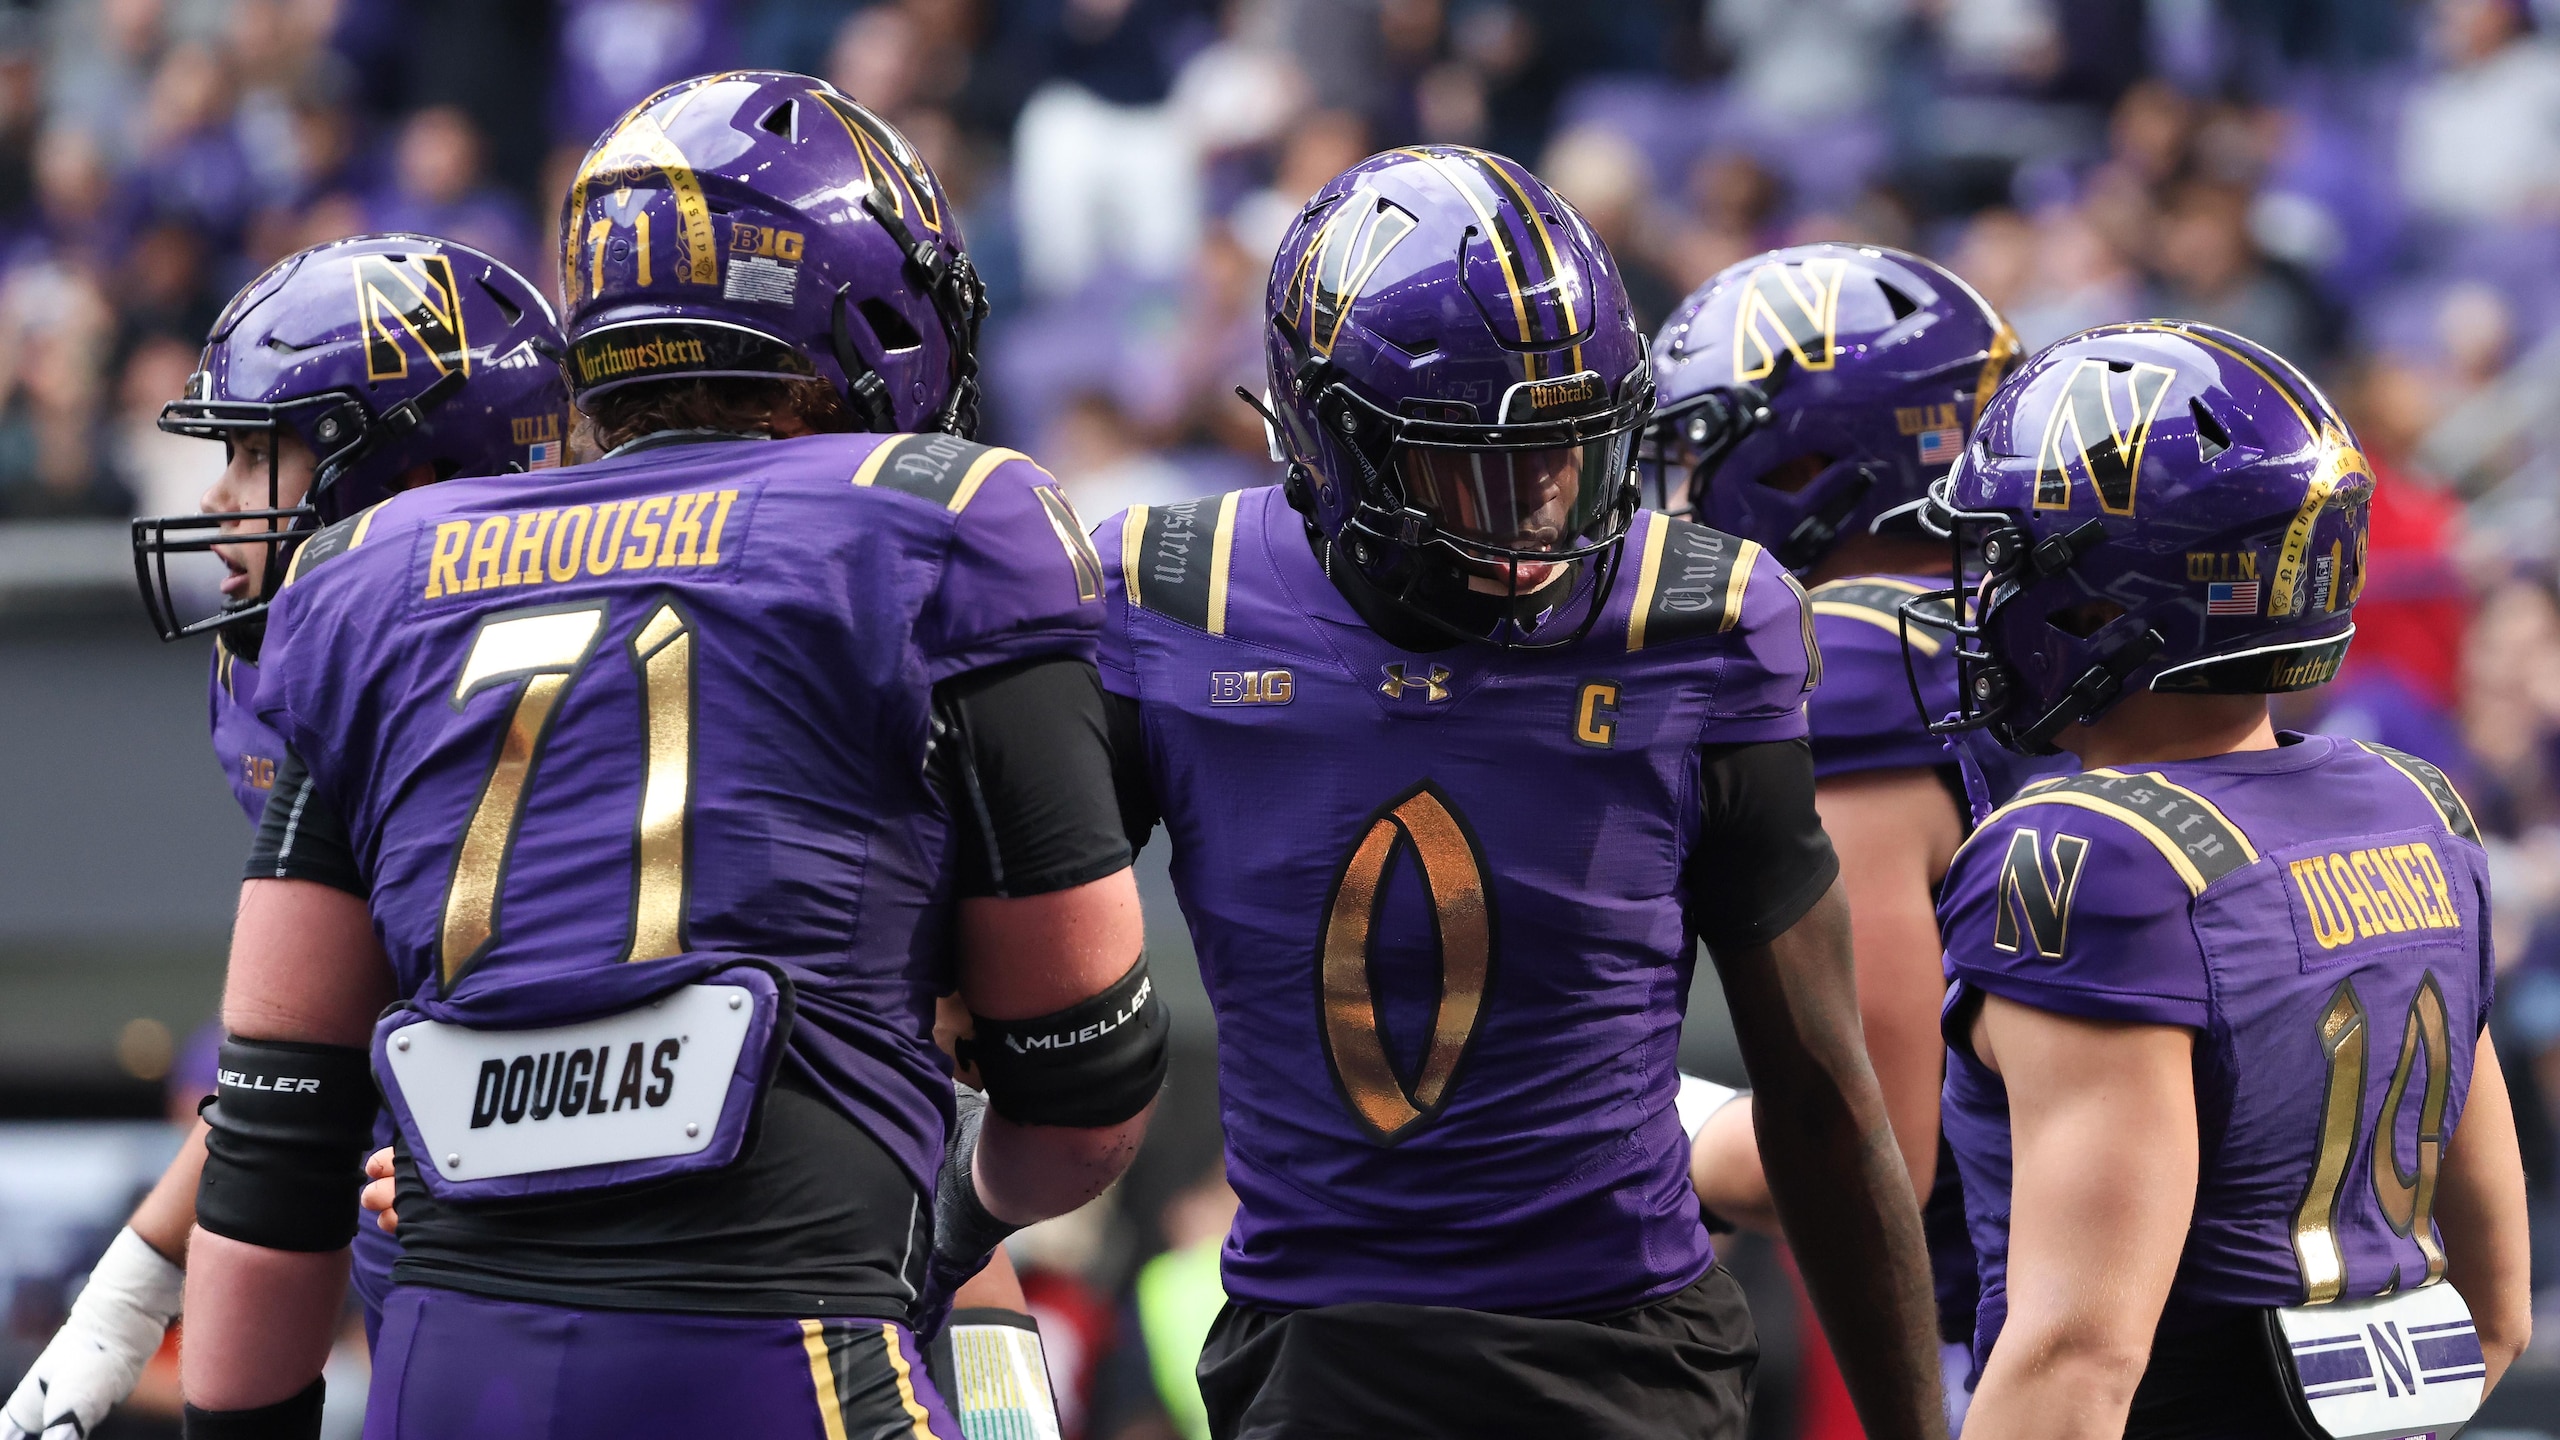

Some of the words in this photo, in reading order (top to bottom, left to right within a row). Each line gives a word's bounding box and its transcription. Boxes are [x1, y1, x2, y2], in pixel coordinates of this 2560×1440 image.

[805, 89, 941, 234] N
[586, 209, 653, 300] 71
[1282, 184, 1418, 358] N
[353, 254, 470, 381] N
[576, 335, 706, 385] Northwestern
[1733, 258, 1848, 383] N
[1530, 377, 1593, 410] Wildcats
[2033, 359, 2177, 517] N
[424, 488, 740, 600] RAHOUSKI
[1573, 679, 1620, 750] C
[433, 594, 695, 995] 71
[1994, 826, 2092, 959] N
[2288, 842, 2461, 951] WAGNER
[1026, 976, 1152, 1050] MUELLER
[1313, 776, 1497, 1148] 0
[217, 1068, 321, 1094] UELLER
[469, 1038, 681, 1129] DOUGLAS
[2368, 1321, 2417, 1398] N
